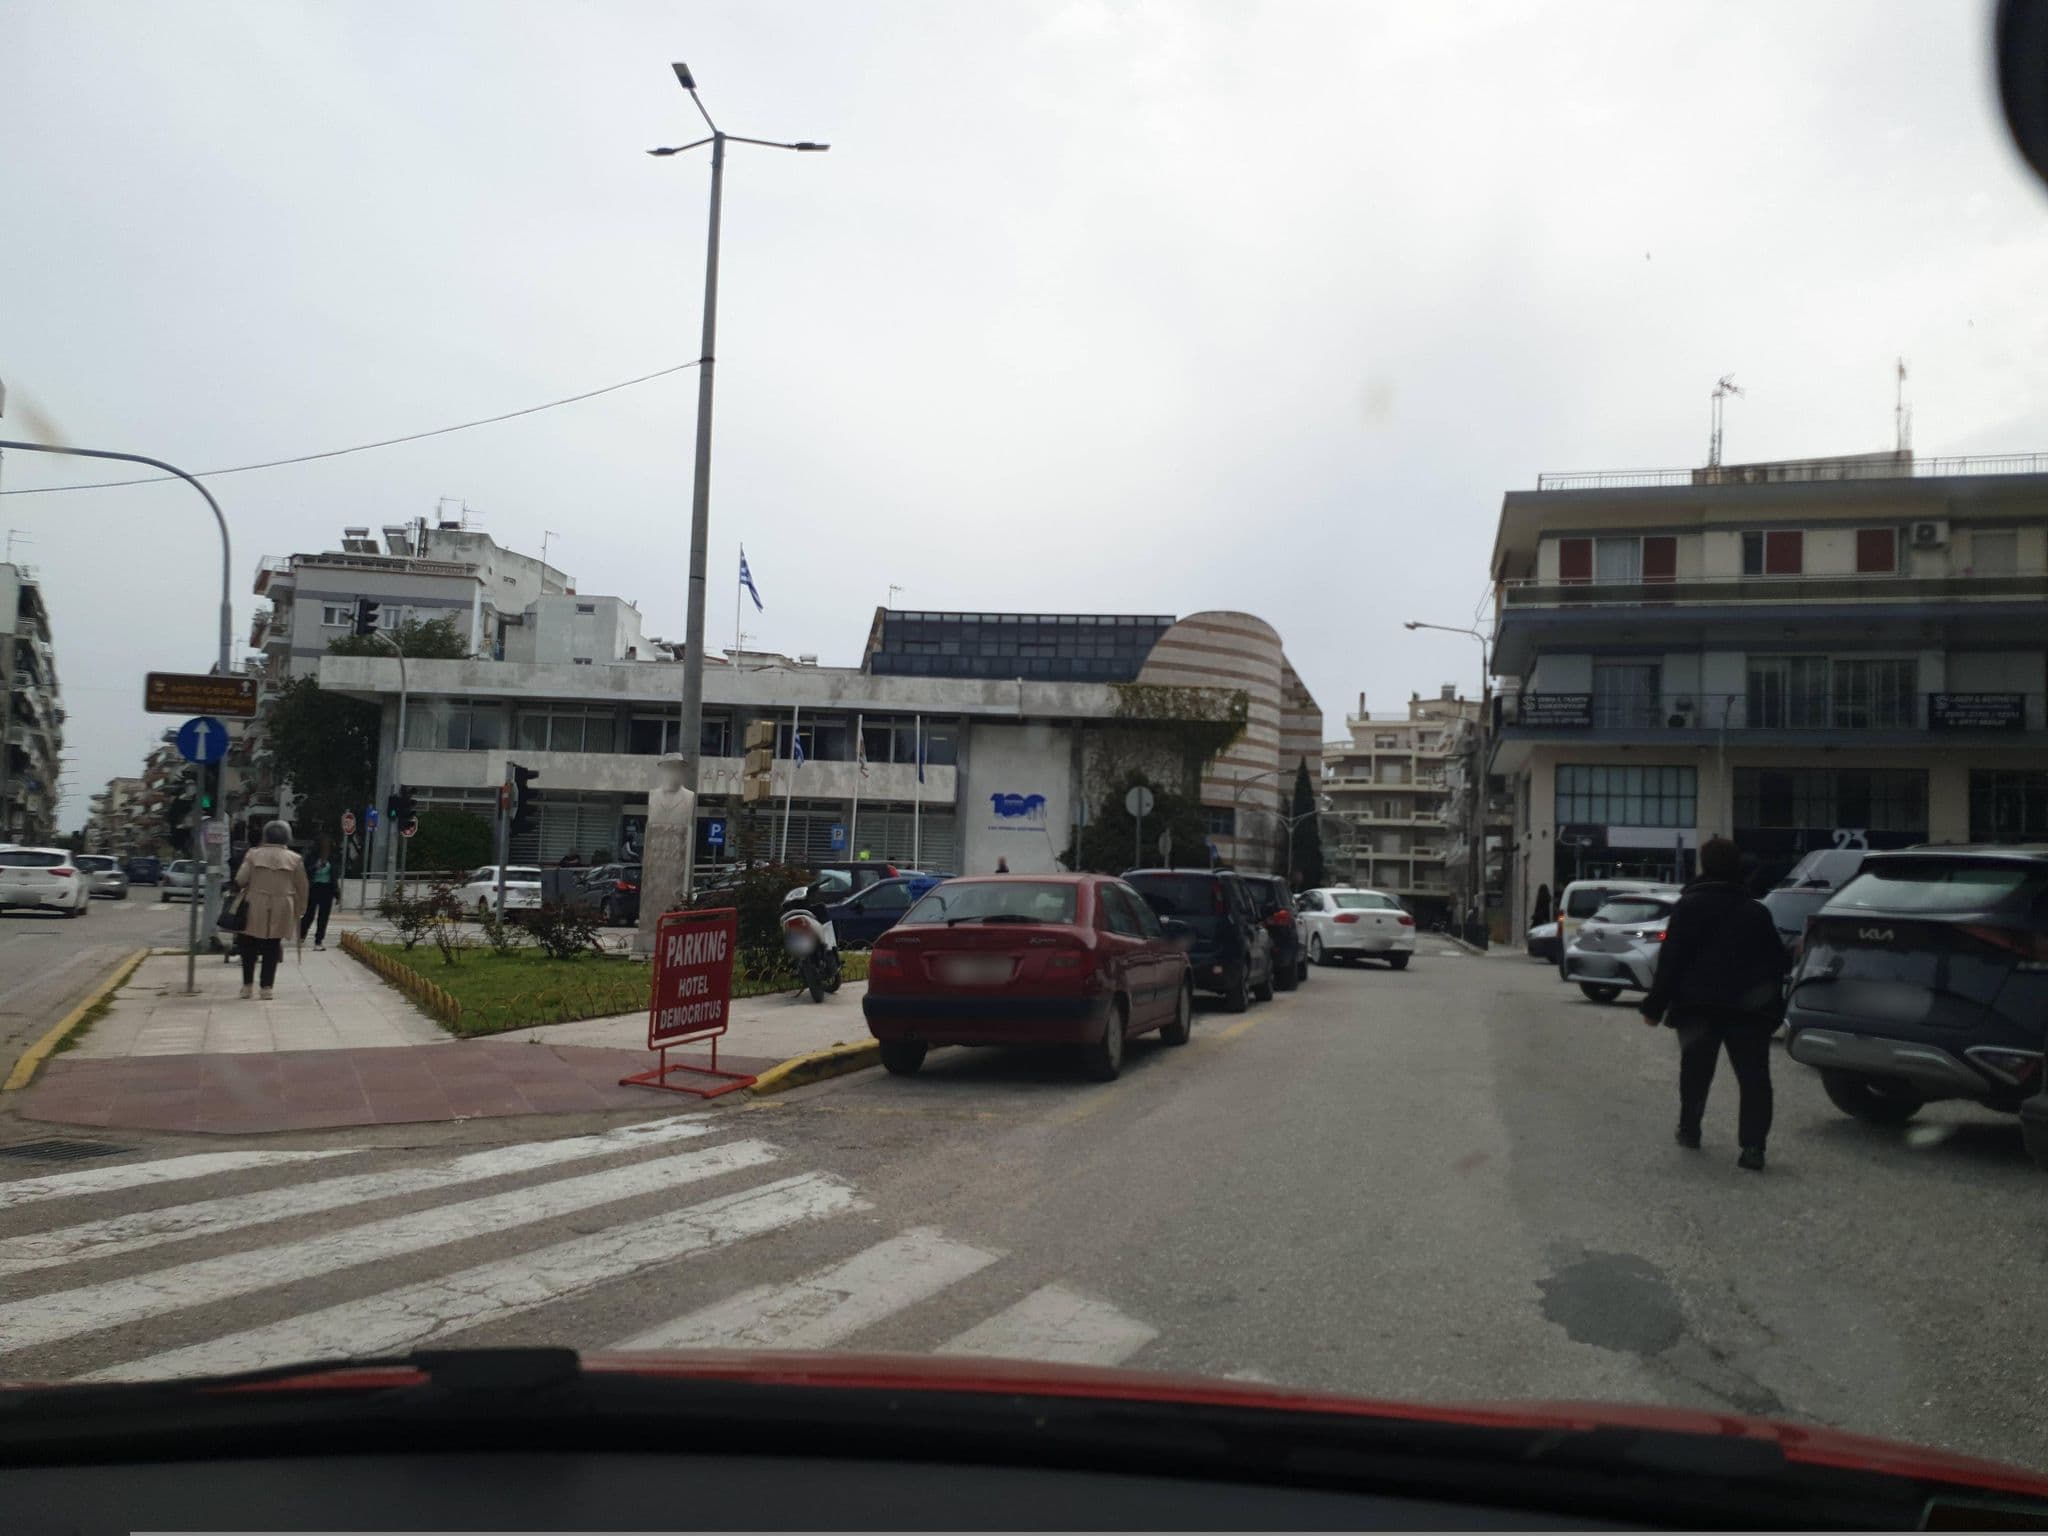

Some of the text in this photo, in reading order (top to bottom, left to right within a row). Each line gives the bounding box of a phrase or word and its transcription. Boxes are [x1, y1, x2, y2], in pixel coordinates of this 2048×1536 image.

[711, 823, 721, 837] P
[666, 929, 727, 968] PARKING
[678, 975, 710, 998] HOTEL
[660, 999, 722, 1030] DEMOCRITUS
